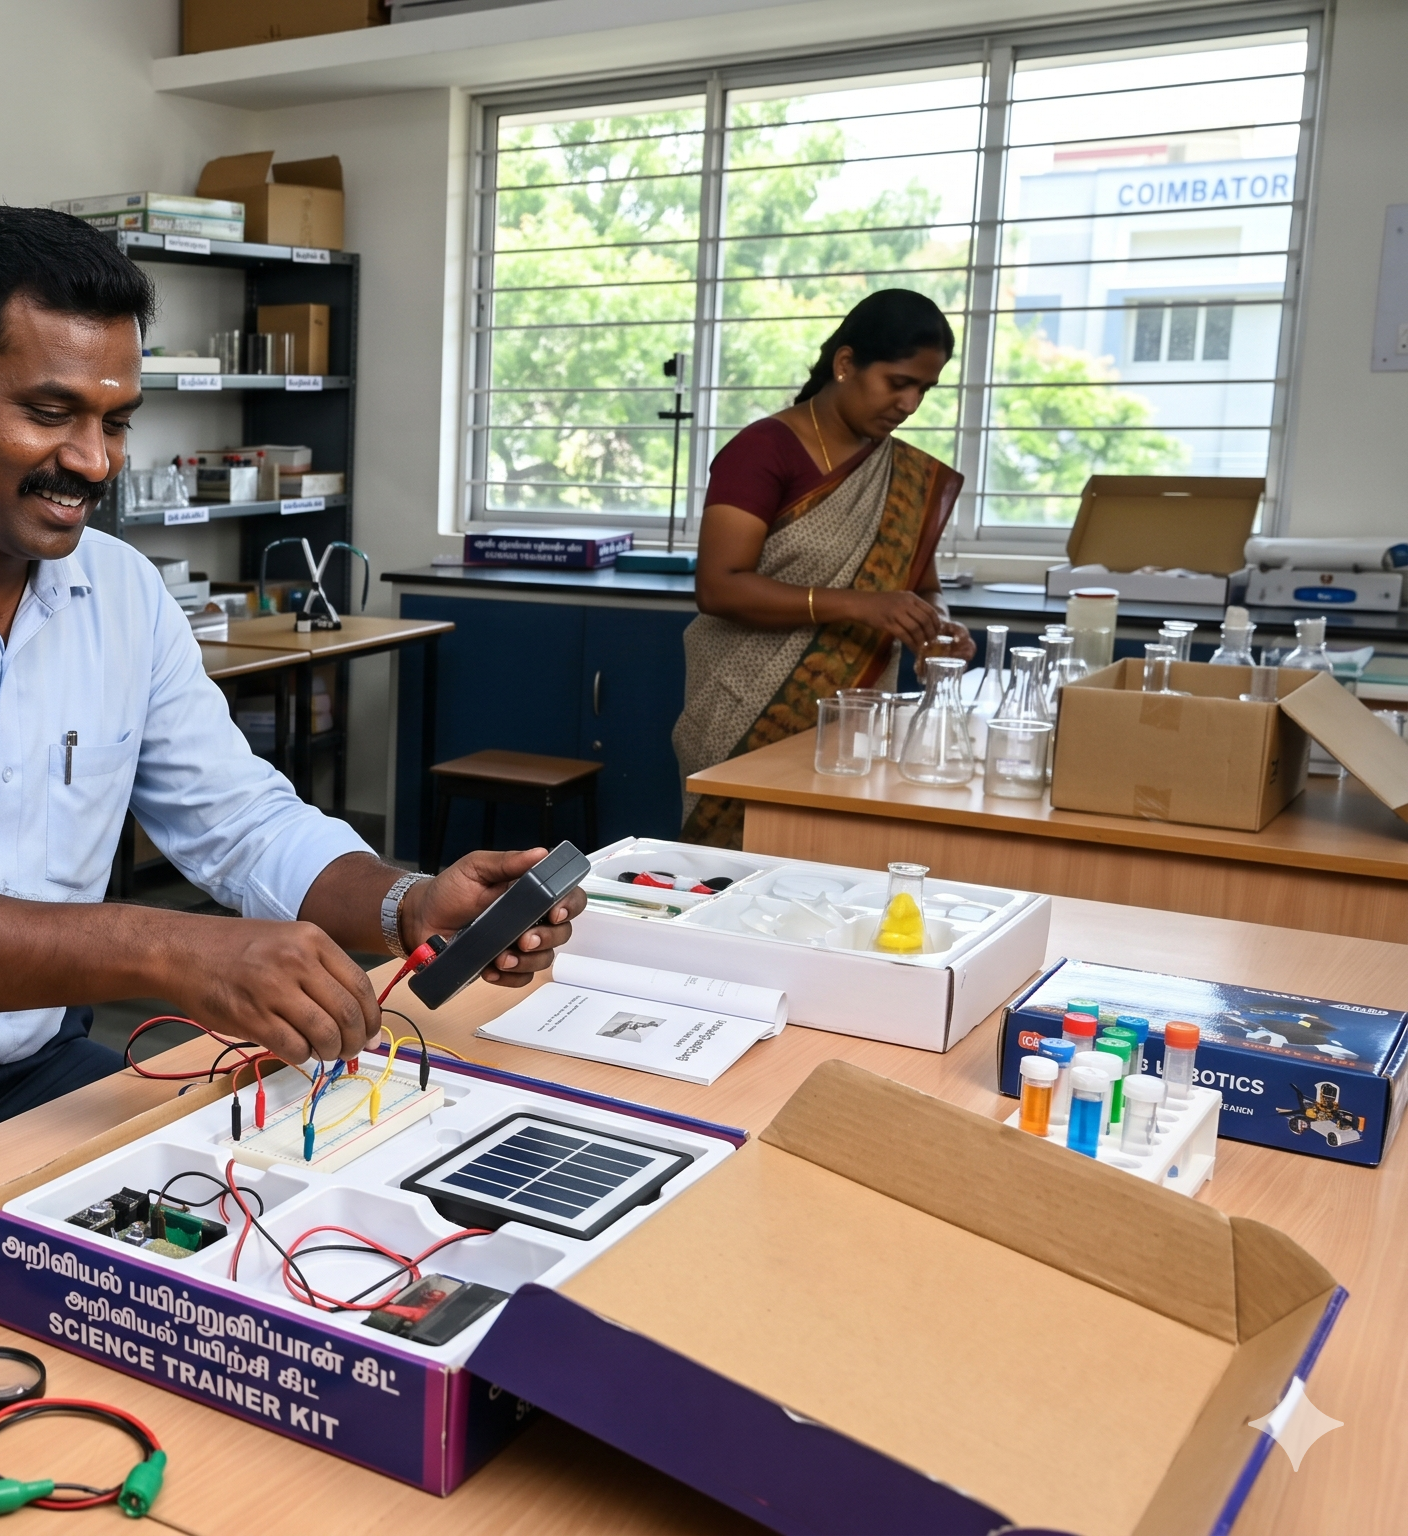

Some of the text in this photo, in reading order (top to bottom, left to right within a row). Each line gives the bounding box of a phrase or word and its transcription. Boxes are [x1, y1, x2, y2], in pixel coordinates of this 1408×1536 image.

[1, 1236, 400, 1396] அறிவியல் பயிற்றுவிப்பான் கிட்
[48, 1312, 339, 1441] SCIENCE TRAINER KIT
[65, 1290, 320, 1400] அறிவியல் பயிற்சி கிட்
